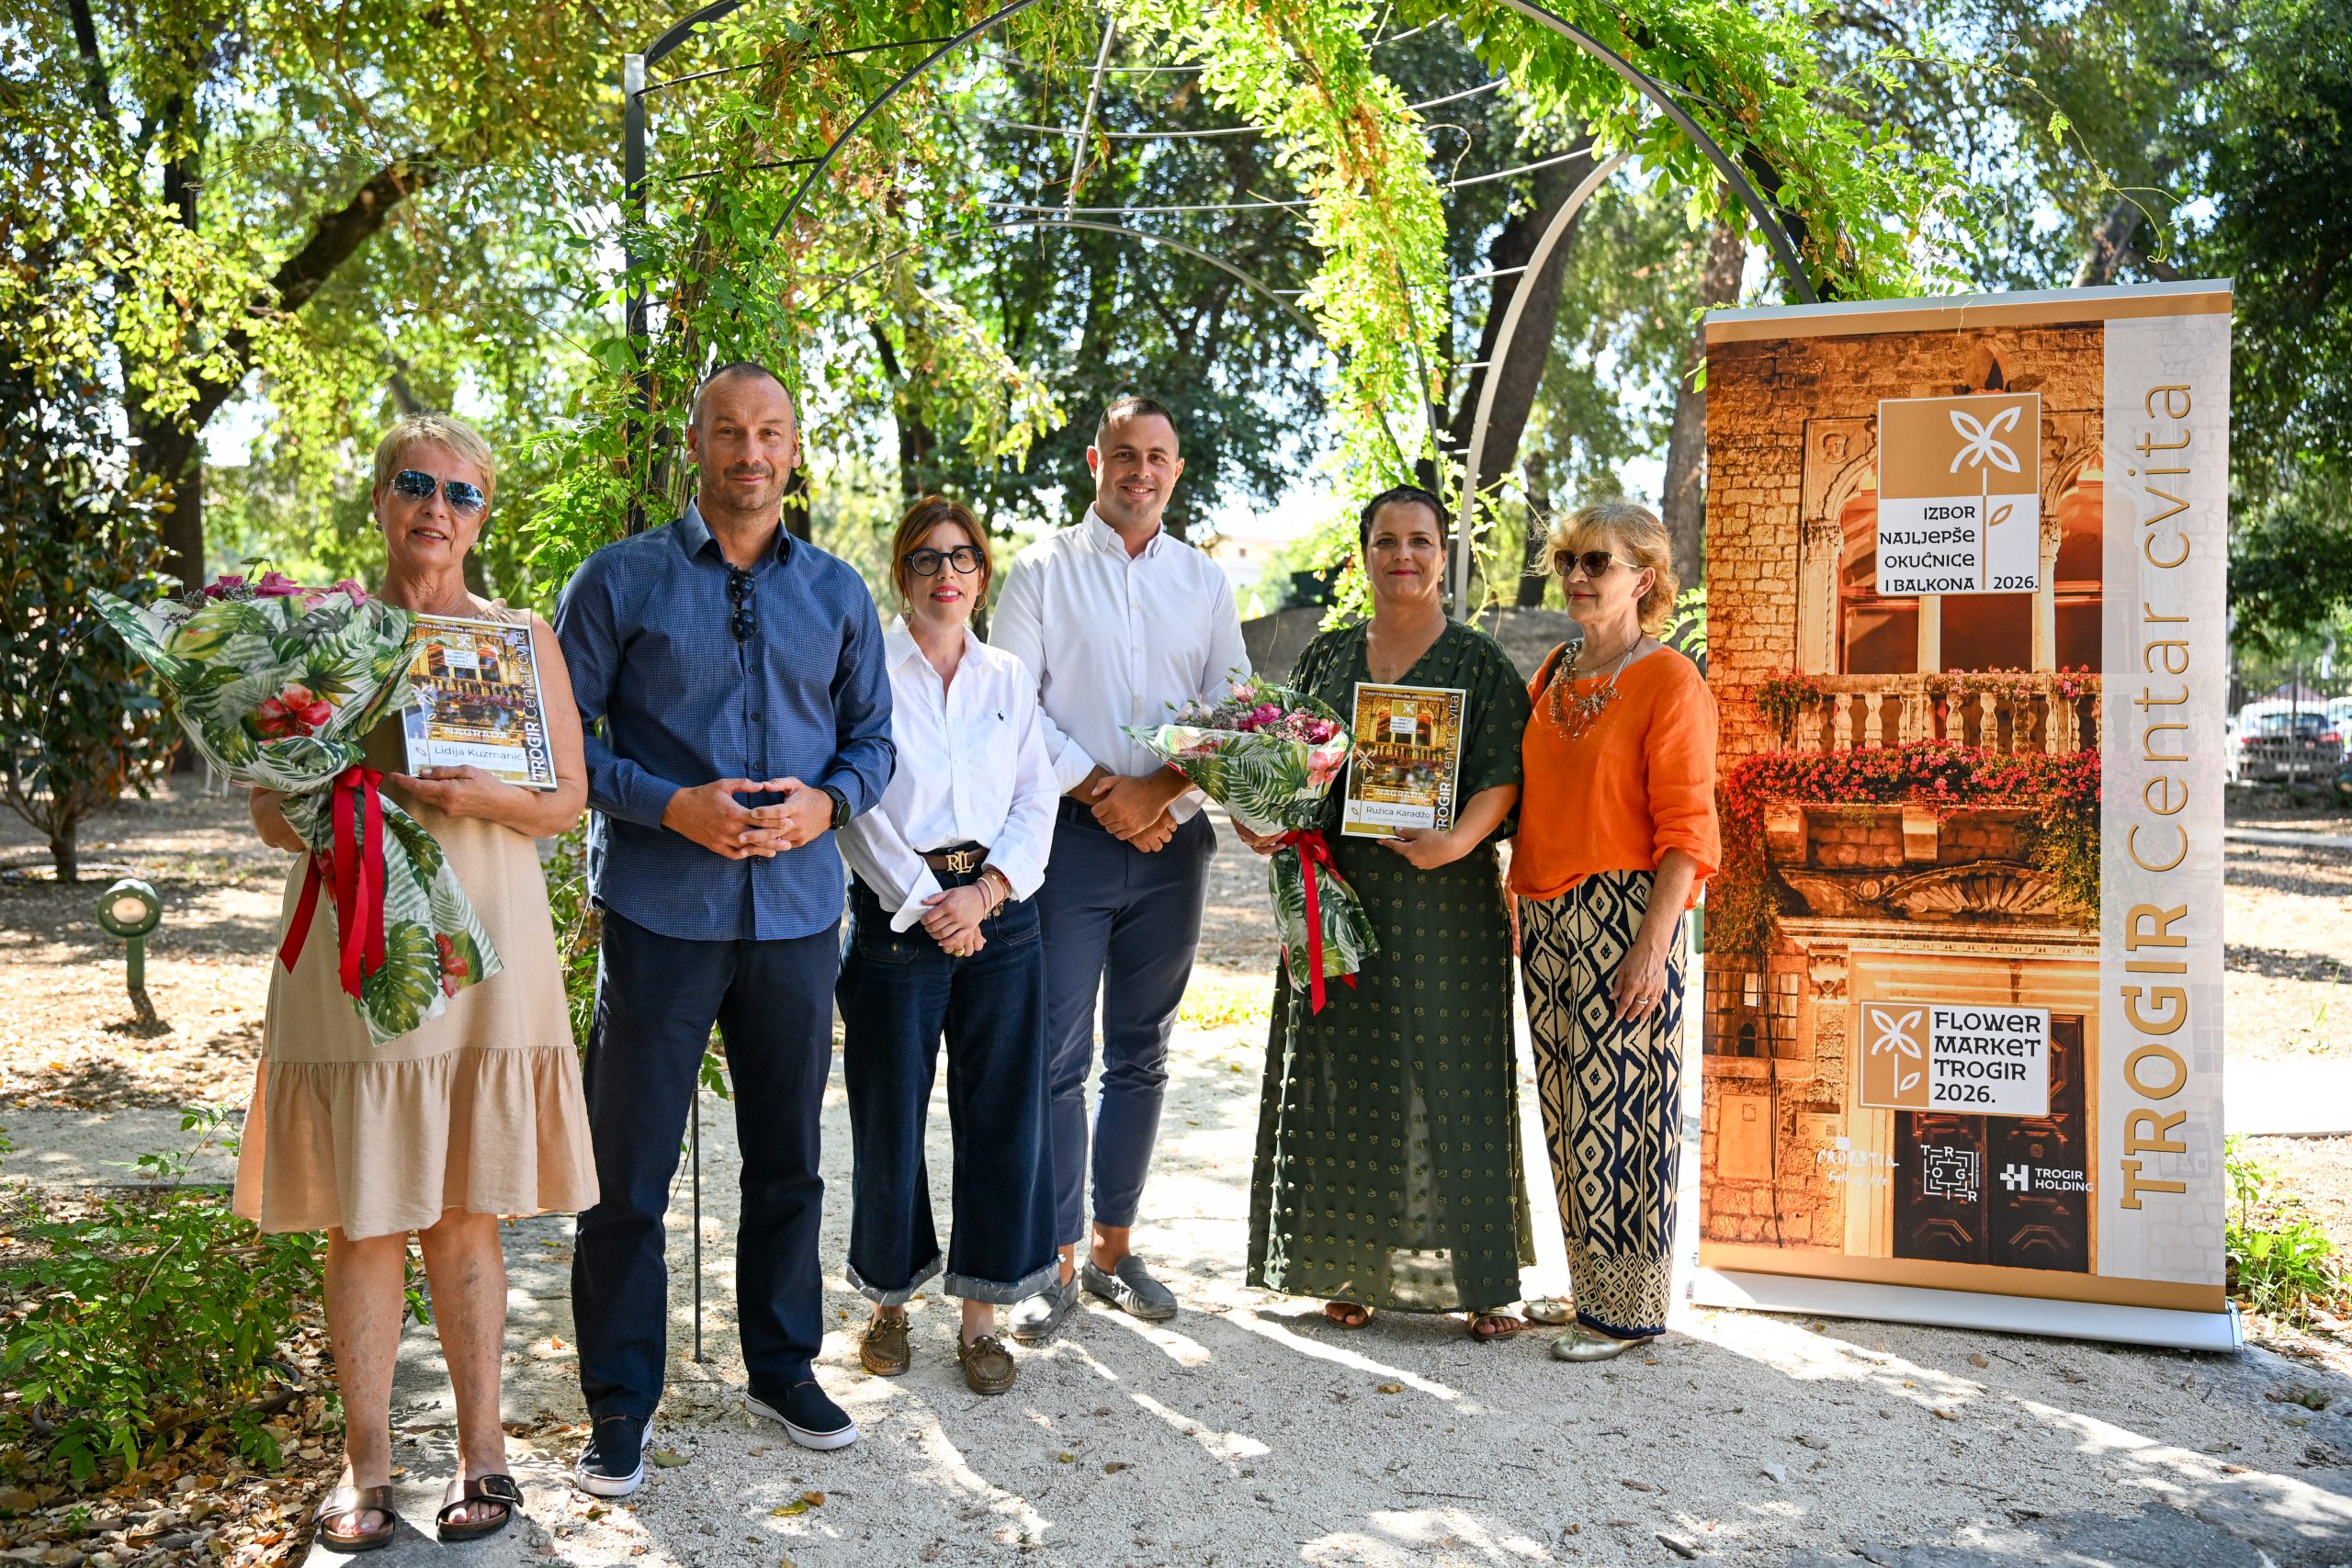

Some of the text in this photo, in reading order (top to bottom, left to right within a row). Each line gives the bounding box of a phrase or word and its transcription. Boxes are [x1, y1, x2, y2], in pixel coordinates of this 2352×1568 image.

[1924, 505, 1975, 521] IZBOR
[1885, 575, 2039, 592] I BALKONA 2026.
[513, 631, 546, 781] TROGIR Centar cvita
[1447, 695, 1460, 728] cvita
[445, 728, 509, 739] NAGRADA
[435, 746, 465, 758] Lidija
[1441, 730, 1455, 780] Centar
[1376, 789, 1425, 799] NAGRADA
[2120, 383, 2191, 1210] TROGIR Centar cvita
[1366, 807, 1430, 818] Ružica Karadžo
[1934, 1058, 2027, 1081] TROGIR
[1934, 1082, 1996, 1103] 2026.
[1816, 1148, 1899, 1168] CROATIA
[2034, 1168, 2084, 1180] TROGIR
[2034, 1179, 2094, 1192] HOLDING
